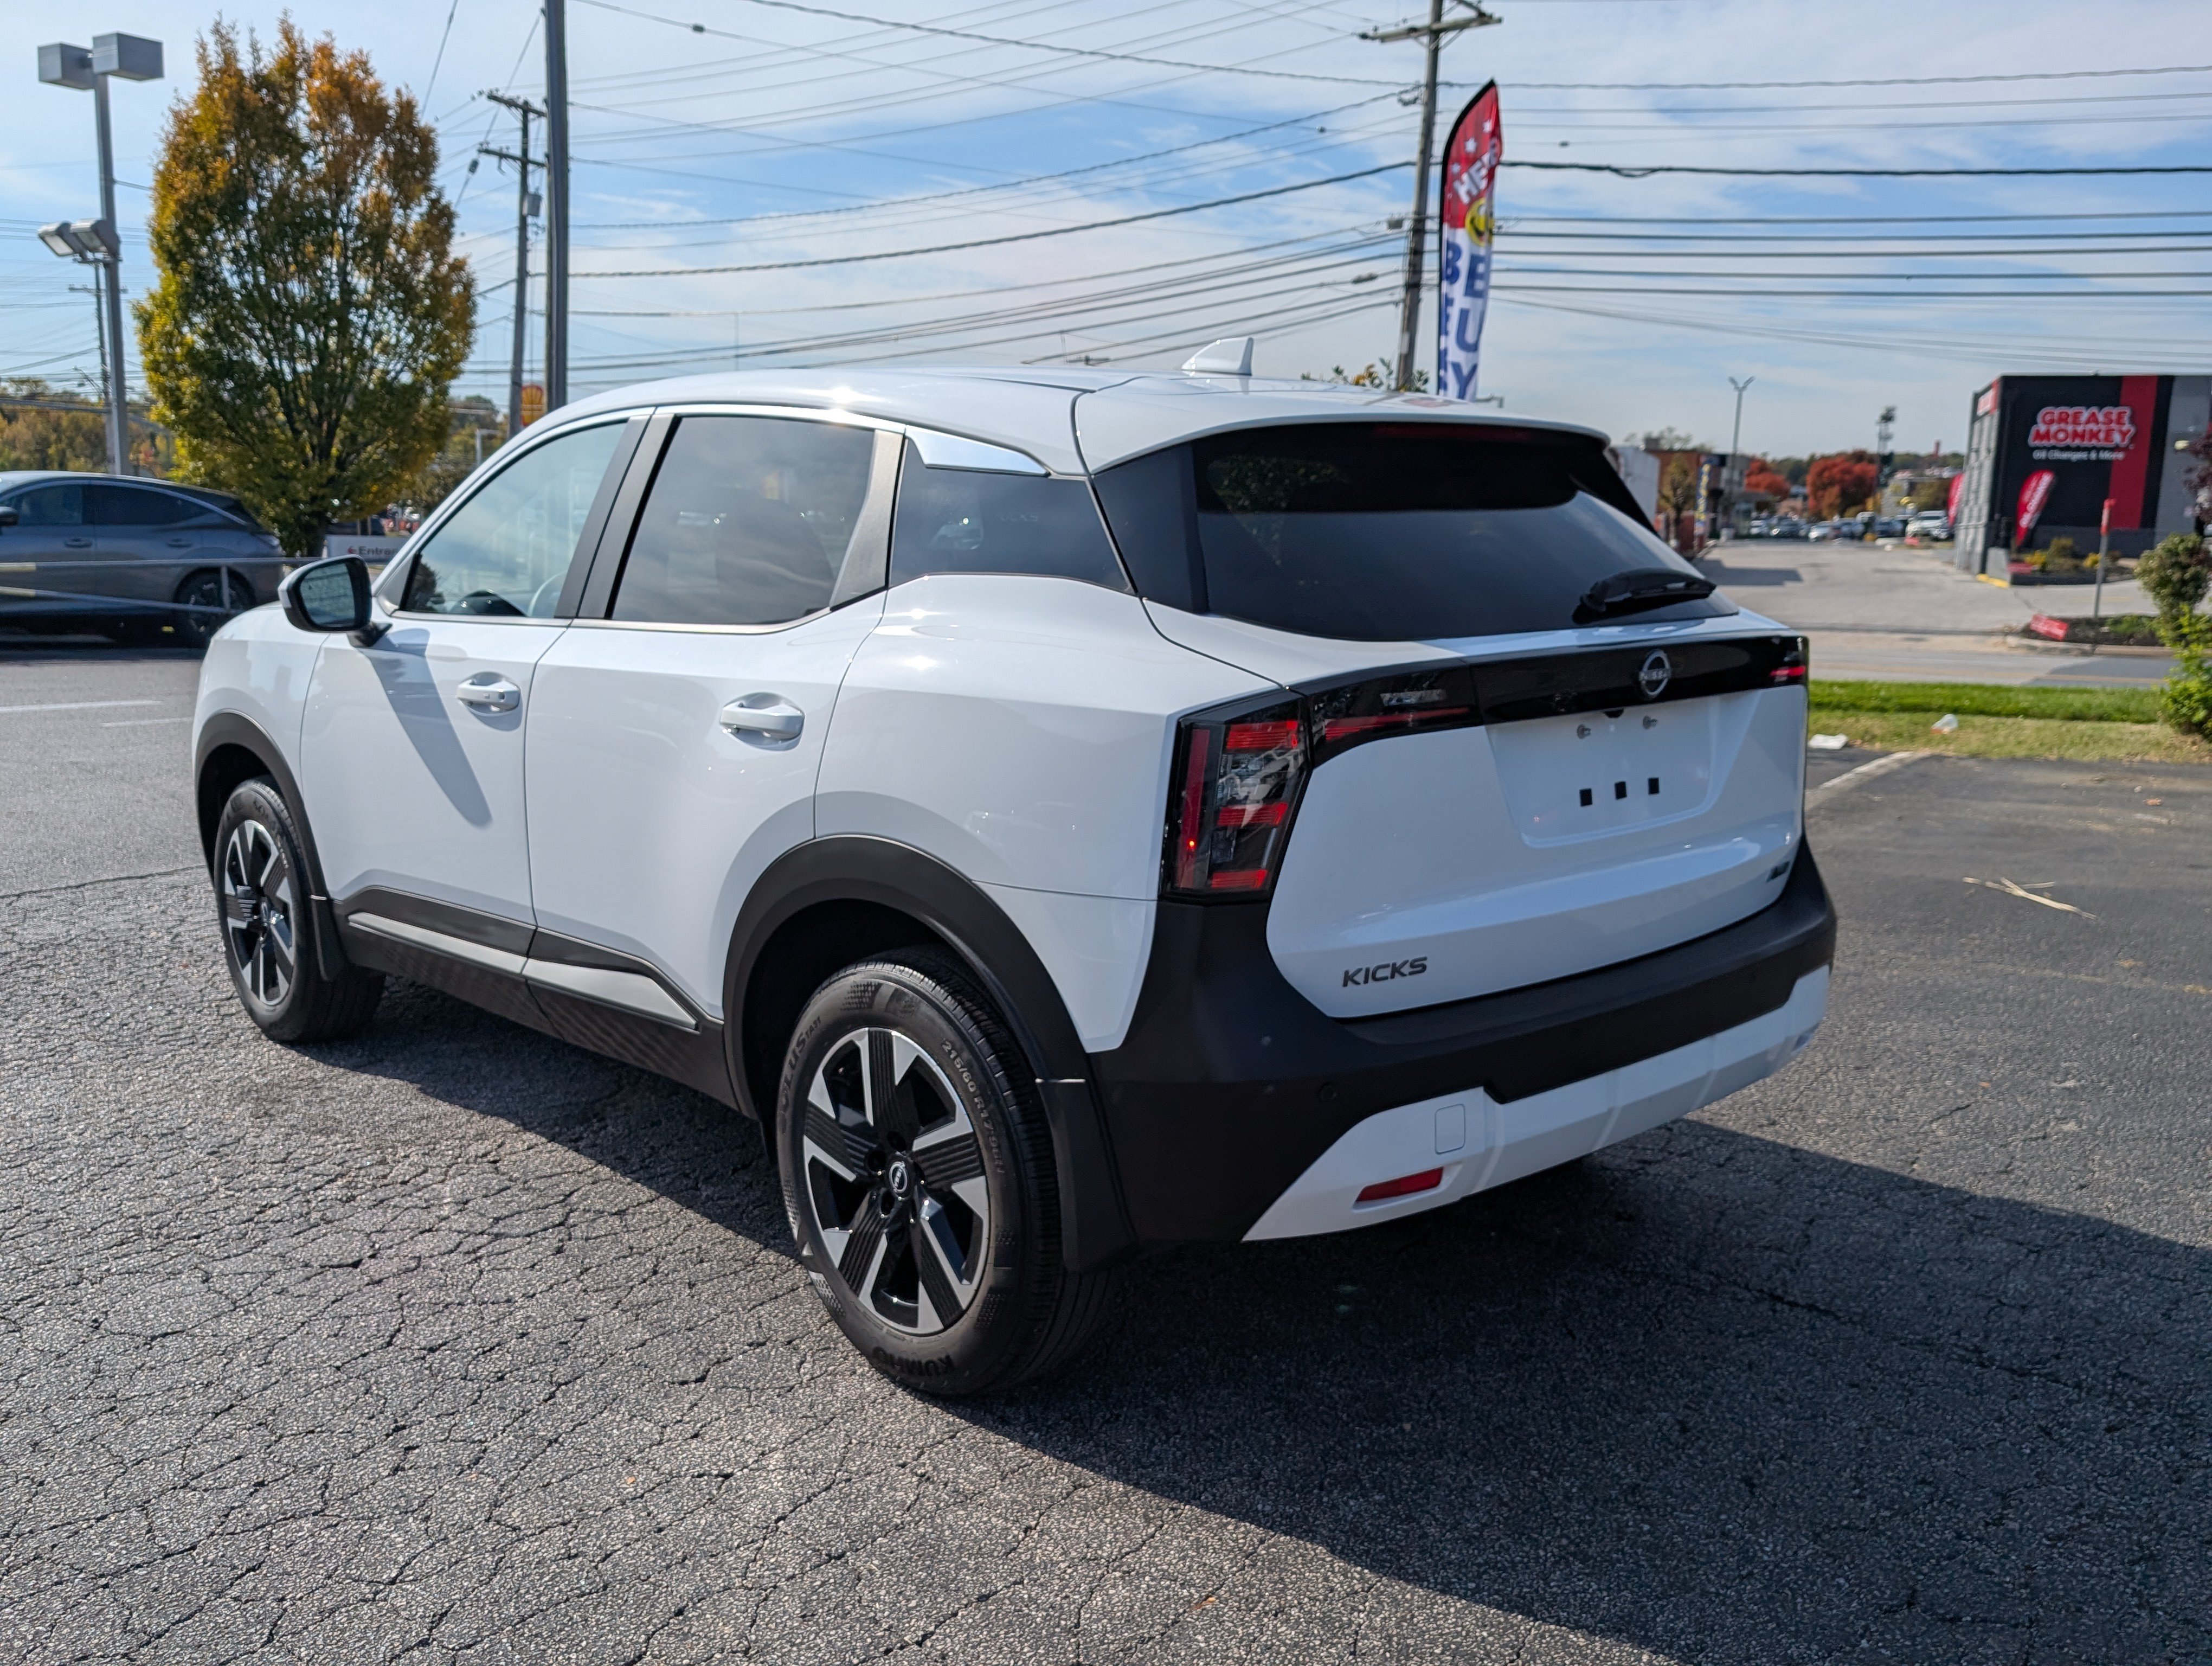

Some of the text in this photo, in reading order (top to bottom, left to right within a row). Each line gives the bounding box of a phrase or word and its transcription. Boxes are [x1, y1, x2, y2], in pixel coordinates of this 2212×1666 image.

[2038, 407, 2132, 426] GREASE
[2029, 425, 2135, 446] MONKEY
[1342, 956, 1427, 988] KICKS
[942, 1040, 977, 1093] 215/60
